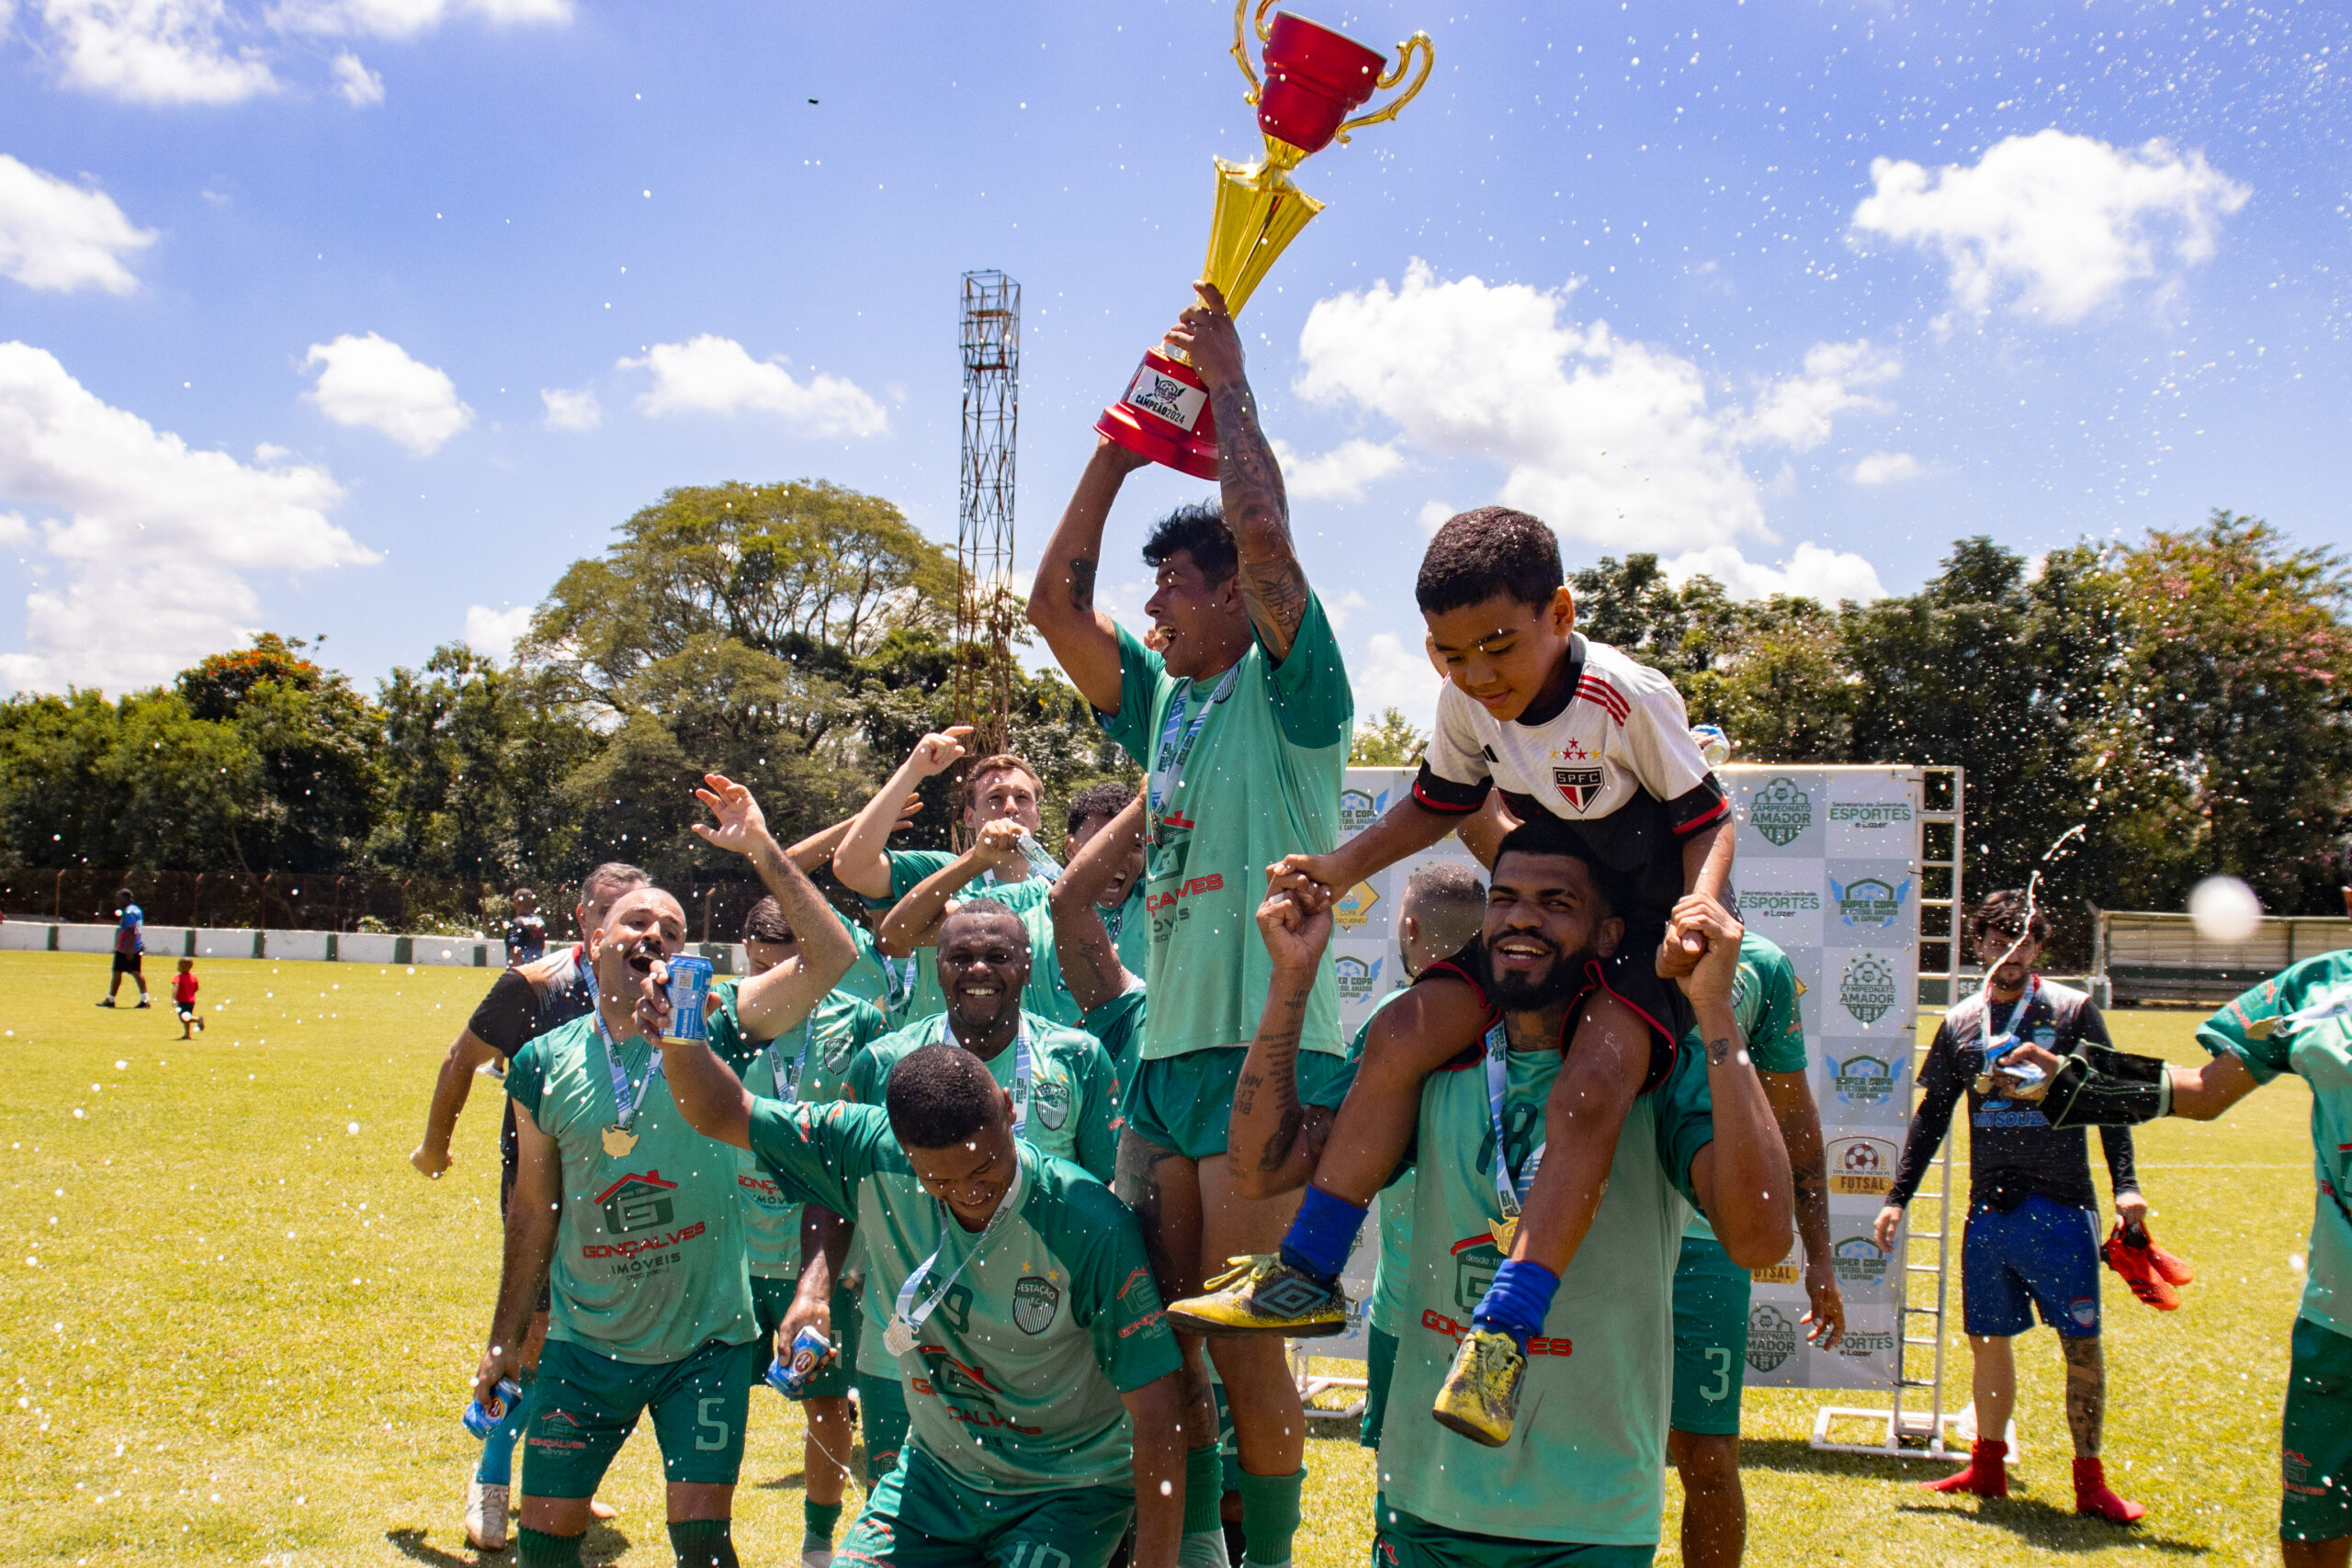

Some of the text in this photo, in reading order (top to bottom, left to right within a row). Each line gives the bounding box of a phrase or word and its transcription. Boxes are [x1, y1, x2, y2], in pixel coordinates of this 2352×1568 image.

[1557, 773, 1600, 784] SPFC
[1751, 813, 1812, 823] AMADOR
[1830, 808, 1911, 820] ESPORTES
[1739, 897, 1820, 909] ESPORTES
[1874, 900, 1898, 908] COPA
[1840, 993, 1894, 1003] AMADOR
[1841, 1176, 1885, 1190] FUTSAL
[582, 1222, 707, 1259] GONÇALVES
[611, 1252, 681, 1275] IMÓVEIS
[1466, 1253, 1490, 1266] desde
[1020, 1283, 1056, 1301] ESTAÇÃO
[1747, 1340, 1796, 1351] MADOR
[1700, 1347, 1732, 1401] 3
[695, 1397, 729, 1451] 5
